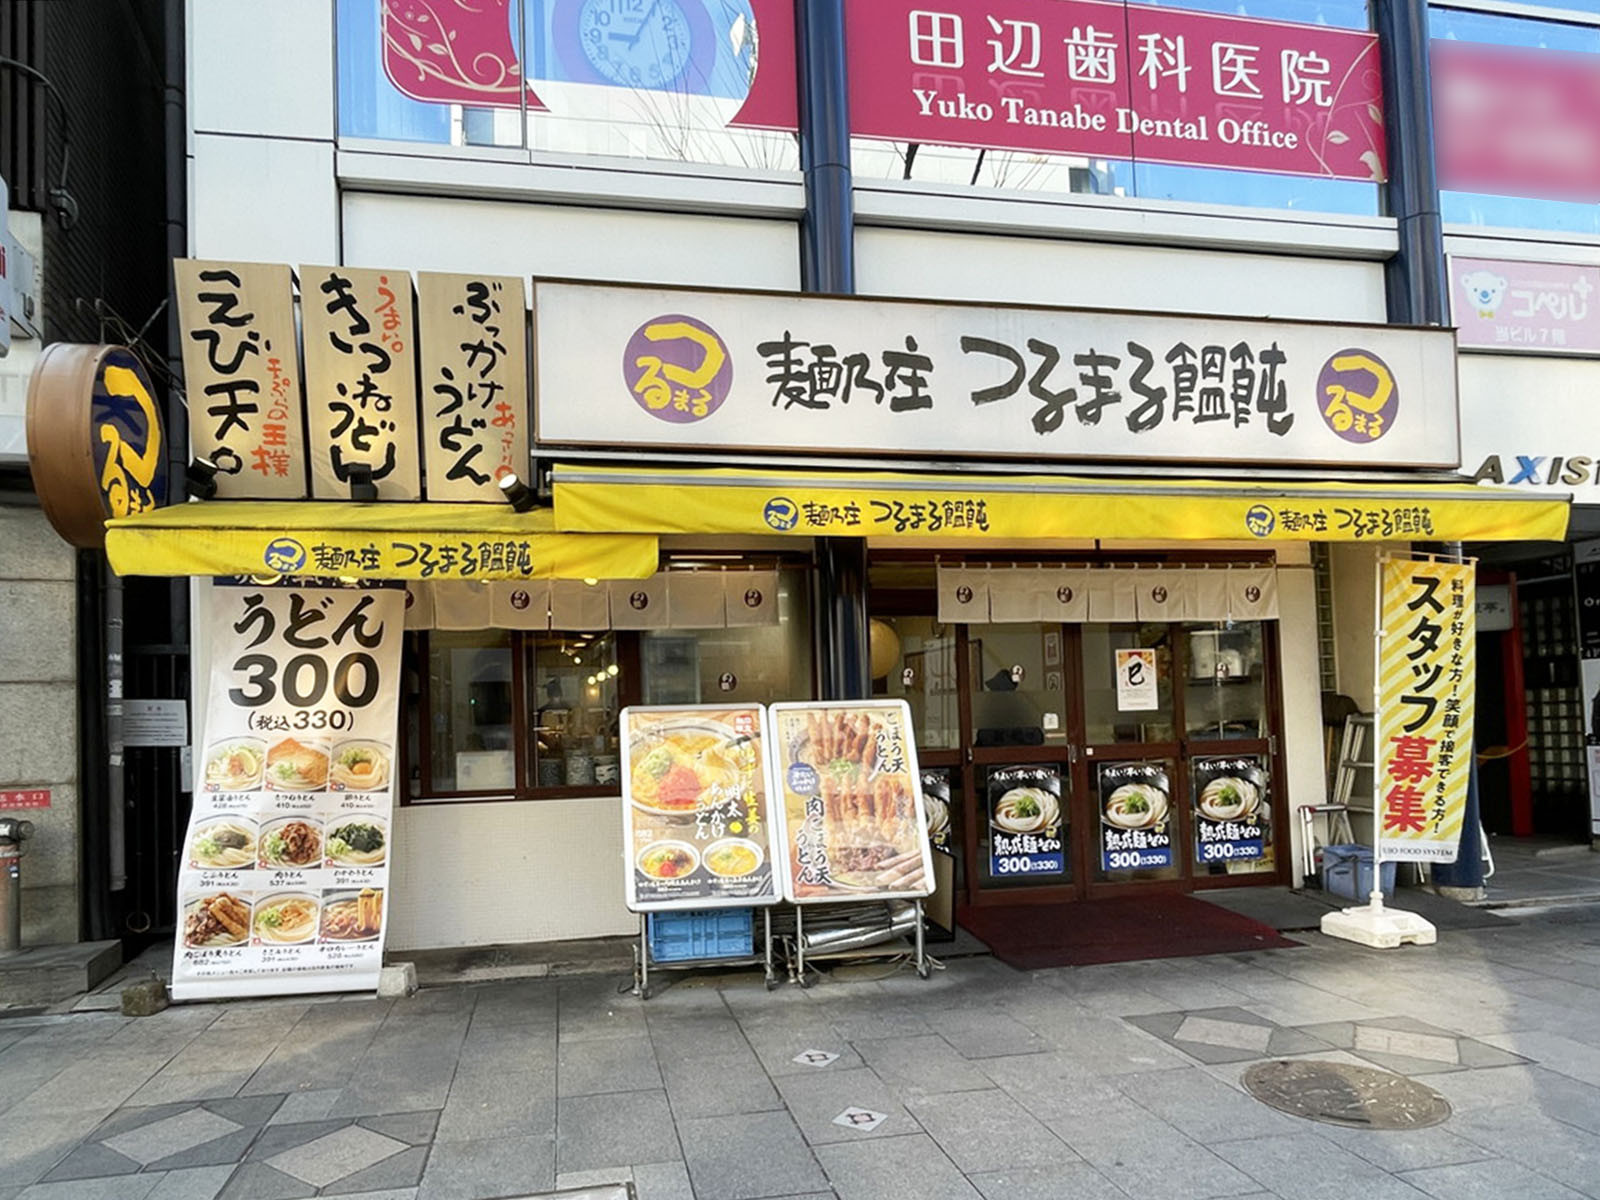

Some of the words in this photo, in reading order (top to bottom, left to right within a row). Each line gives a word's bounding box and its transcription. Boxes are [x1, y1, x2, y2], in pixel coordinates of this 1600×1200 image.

[908, 9, 1333, 108] 田辺歯科医院
[912, 88, 993, 122] Yuko
[1001, 97, 1106, 132] Tanabe
[1116, 108, 1209, 142] Dental
[1217, 119, 1298, 150] Office
[633, 321, 726, 417] つるまる
[960, 335, 1295, 437] つるまる饂飩
[1325, 354, 1394, 438] つるまる
[233, 592, 385, 651] うどん
[228, 652, 381, 708] 300
[1383, 575, 1446, 833] スタッフ募集
[246, 710, 355, 732] (税込330)
[998, 856, 1030, 873] 300
[1109, 851, 1140, 868] 300
[1204, 842, 1234, 859] 300
